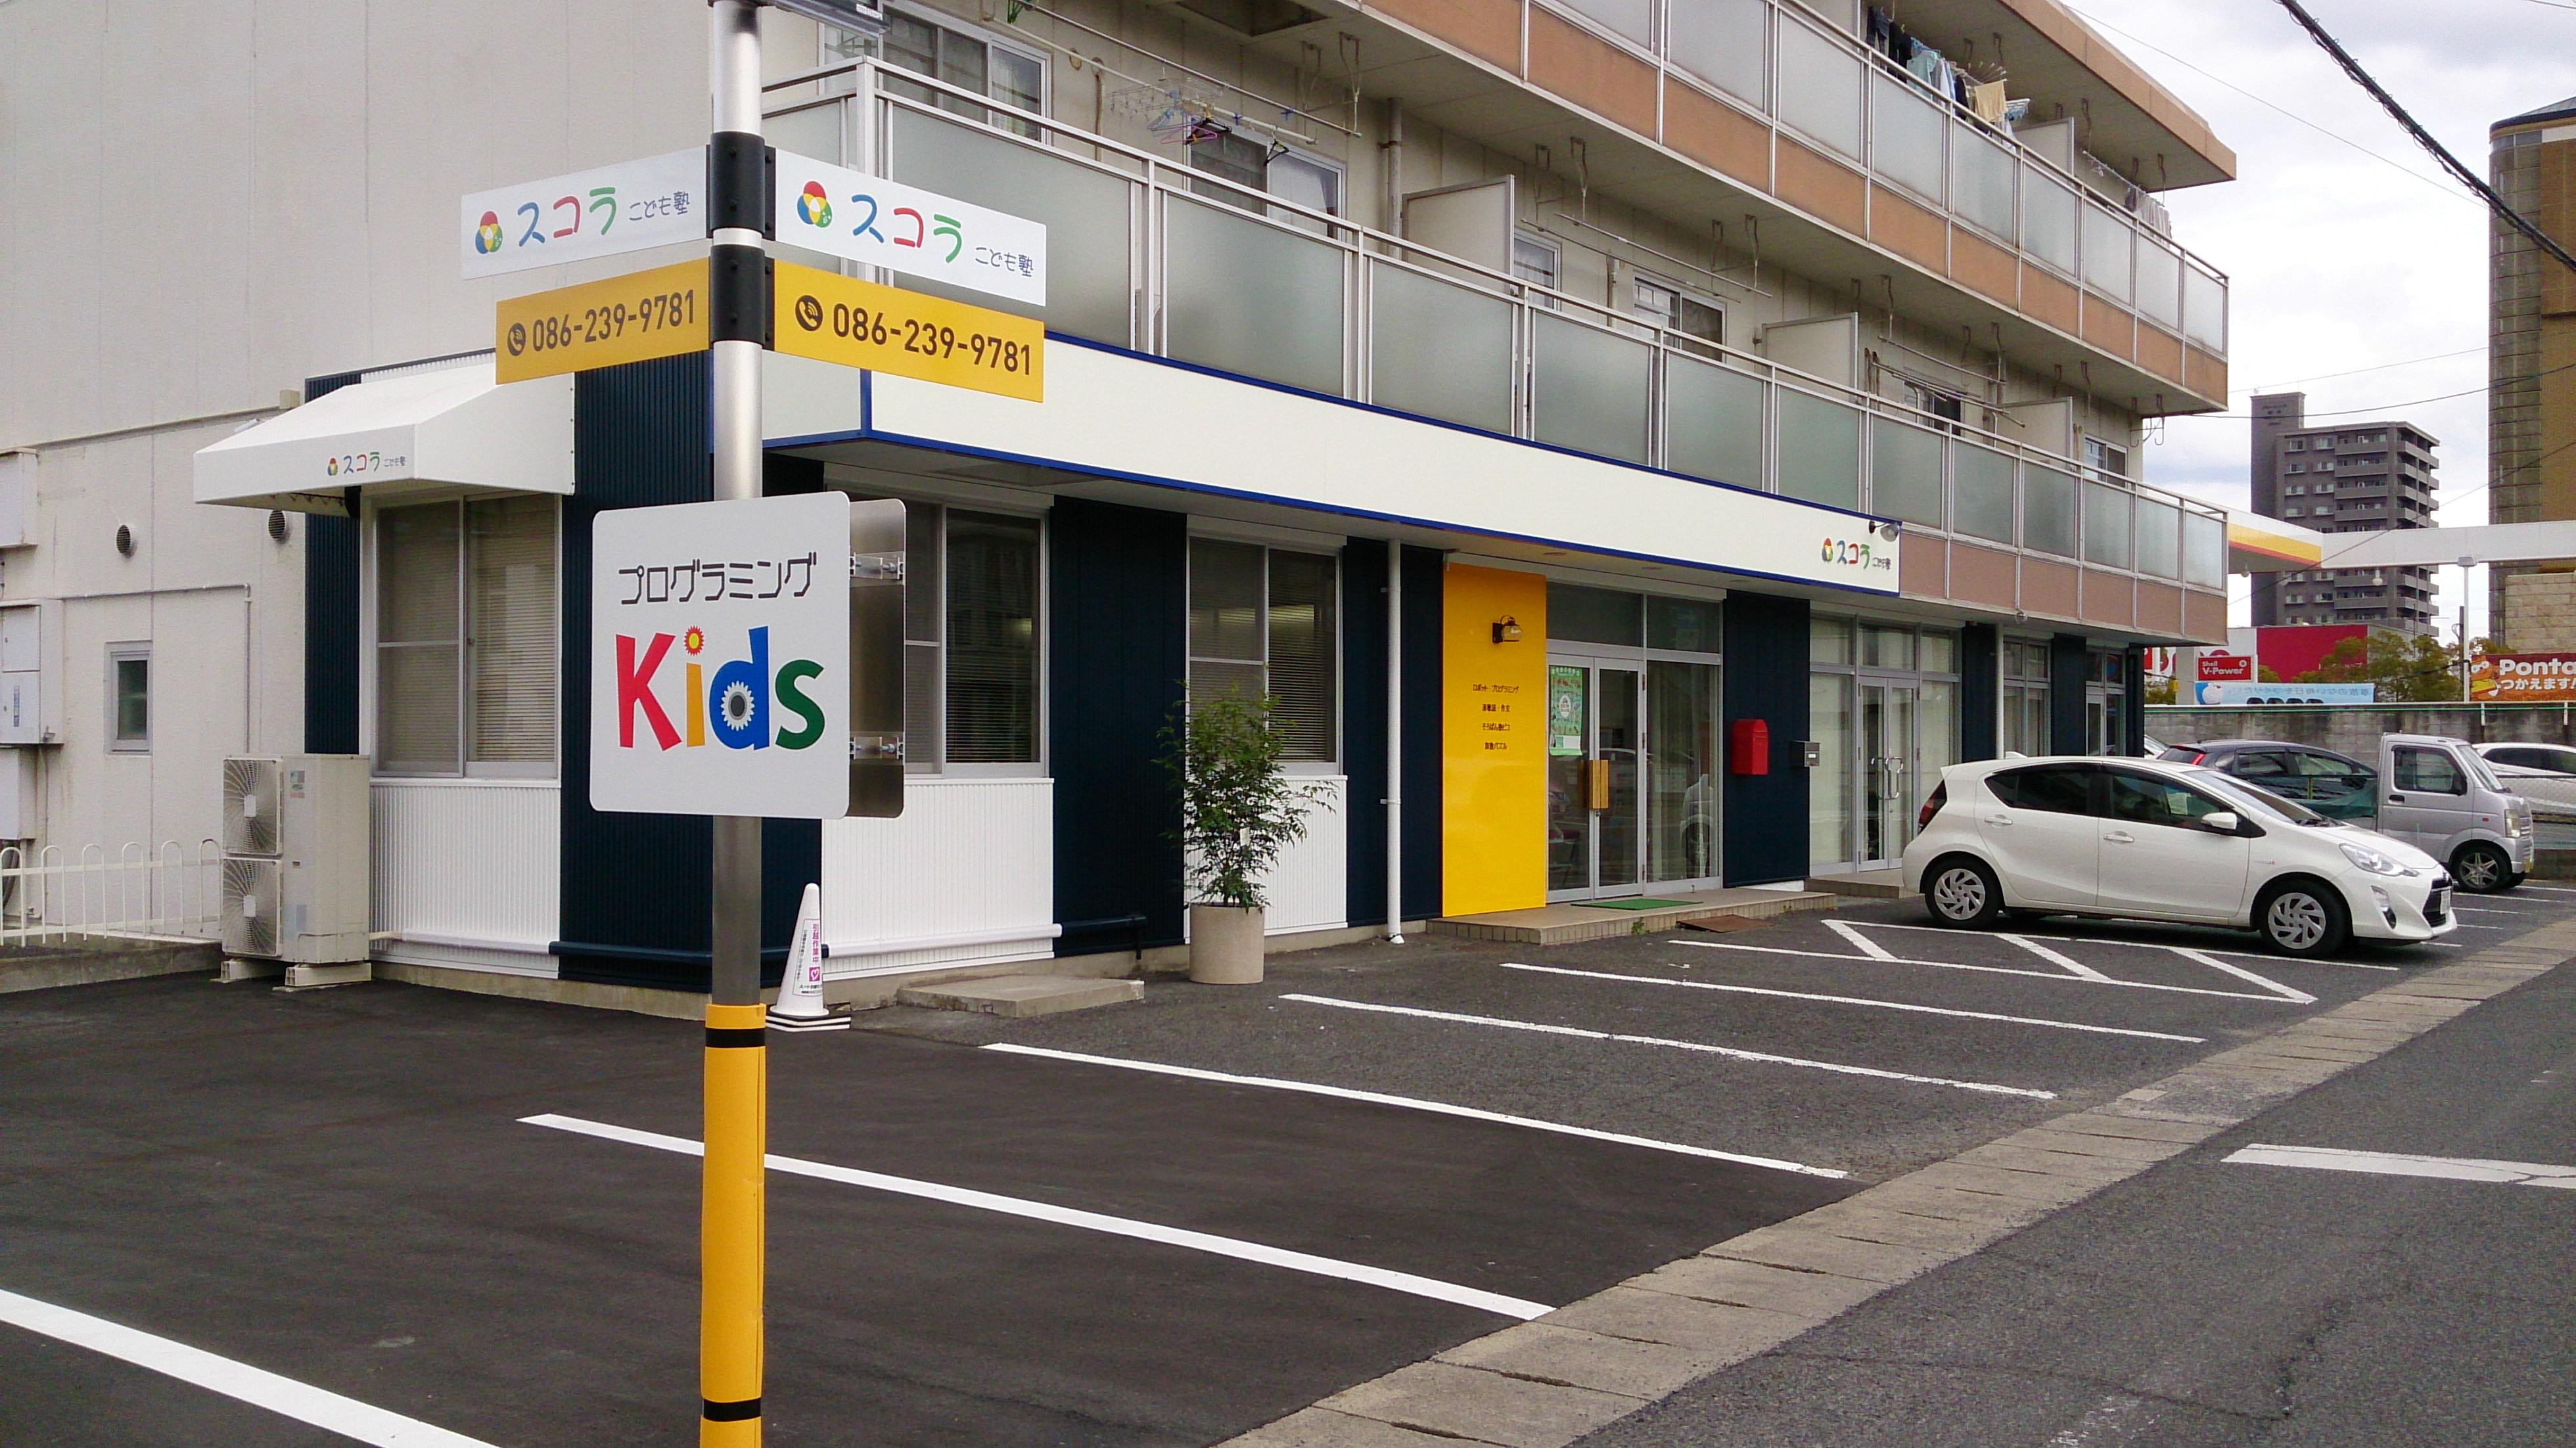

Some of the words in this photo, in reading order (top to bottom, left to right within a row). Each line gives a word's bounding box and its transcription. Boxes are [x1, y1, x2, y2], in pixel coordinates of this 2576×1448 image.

[517, 187, 616, 247] スコラ
[629, 191, 690, 221] こども塾
[852, 194, 963, 263] スコラ
[975, 246, 1034, 277] こども塾
[532, 289, 695, 351] 086-239-9781
[833, 303, 1032, 376] 086-239-9781
[344, 451, 380, 474] スコラ
[618, 552, 817, 604] プログラミング
[1837, 540, 1870, 570] スコラ
[616, 625, 825, 751] Kids
[2499, 658, 2576, 676] Ponta
